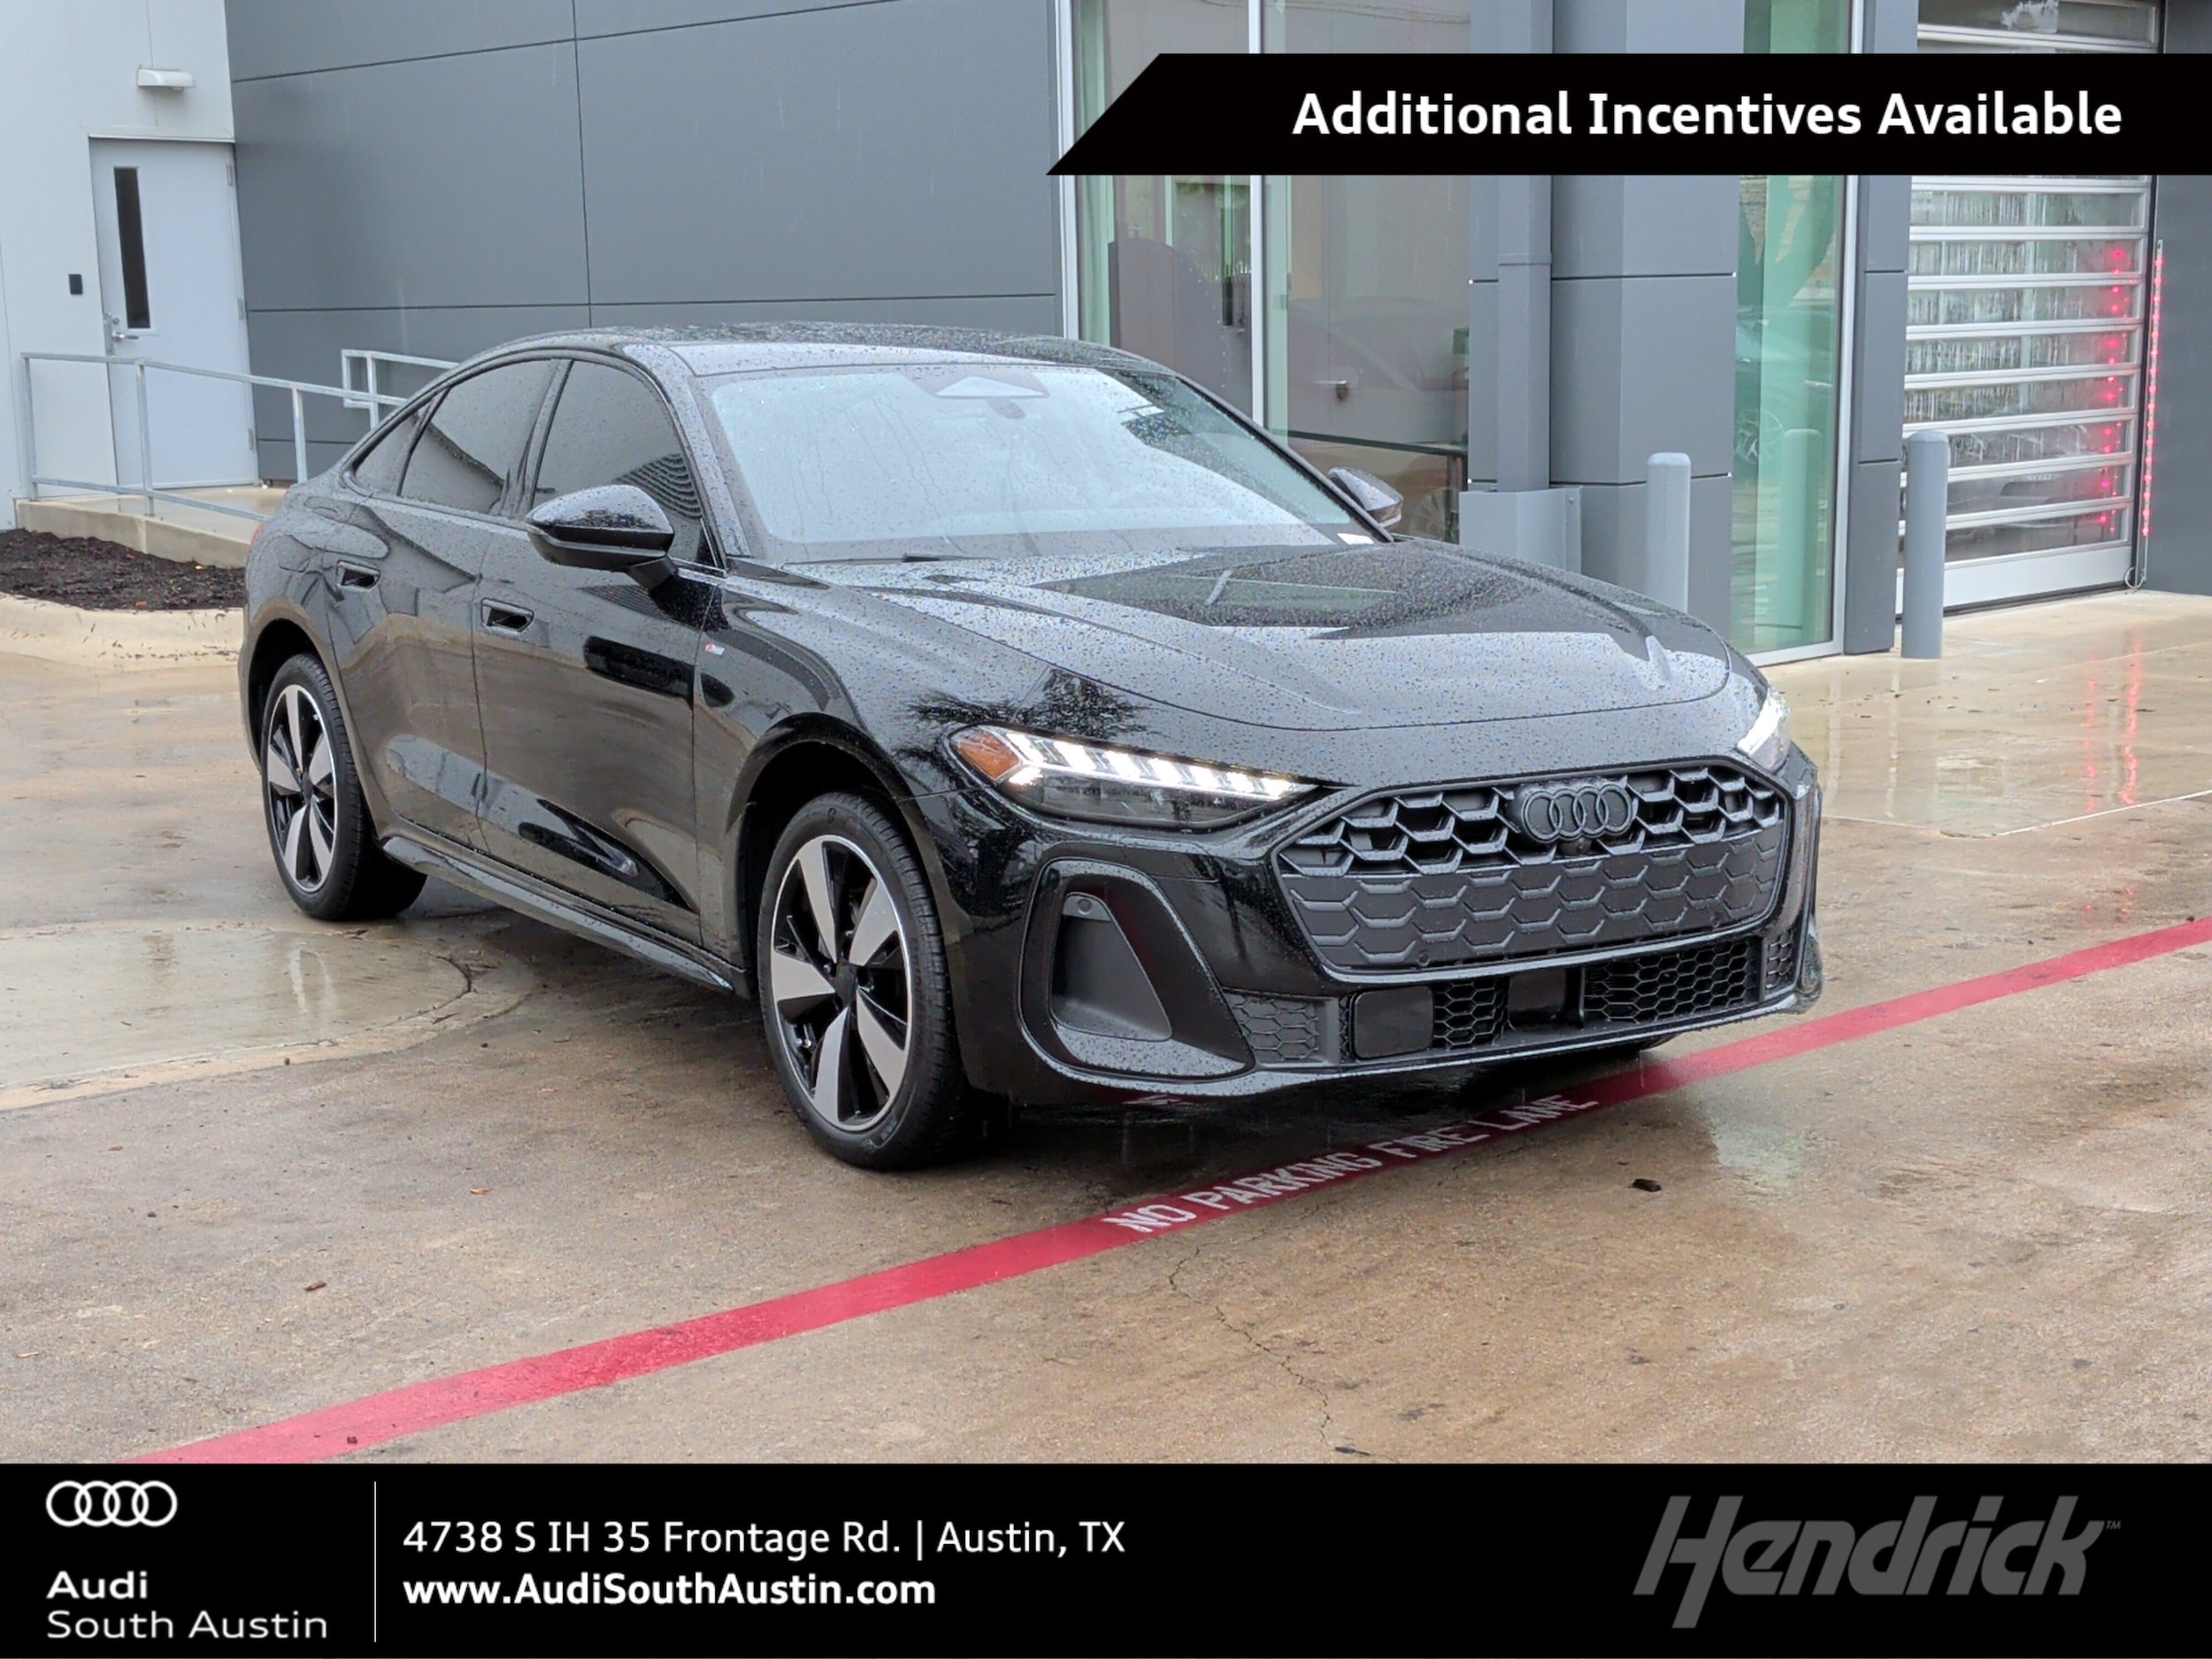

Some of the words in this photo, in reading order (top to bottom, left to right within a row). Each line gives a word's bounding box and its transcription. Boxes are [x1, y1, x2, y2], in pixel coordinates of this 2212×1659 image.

[1102, 1204, 1197, 1233] NO
[1180, 1152, 1383, 1210] PARKING
[1367, 1125, 1490, 1158] FIRE
[1468, 1094, 1599, 1130] LANE
